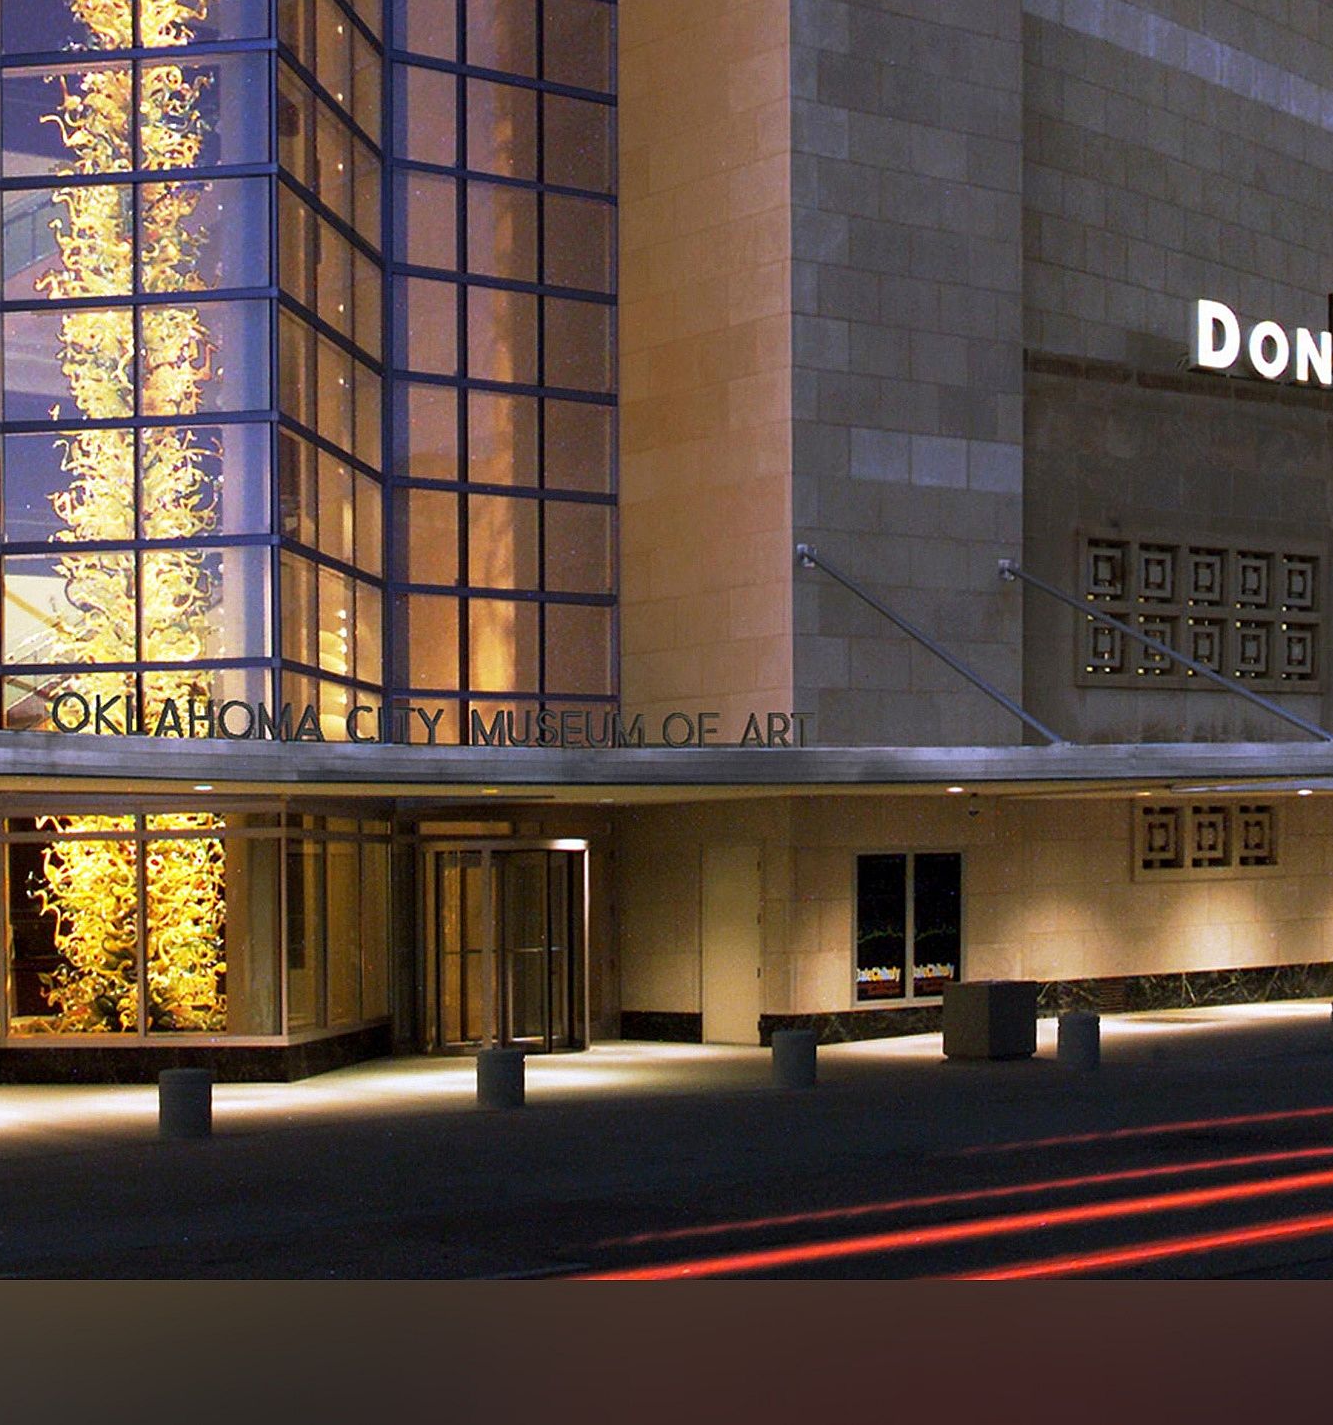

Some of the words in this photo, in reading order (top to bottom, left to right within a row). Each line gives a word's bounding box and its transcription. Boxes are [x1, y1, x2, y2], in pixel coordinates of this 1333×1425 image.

[51, 691, 324, 743] OKLAHOMA
[346, 705, 444, 745] CITY
[470, 708, 646, 748] MUSEUM
[662, 711, 721, 748] OF
[738, 711, 815, 748] ART
